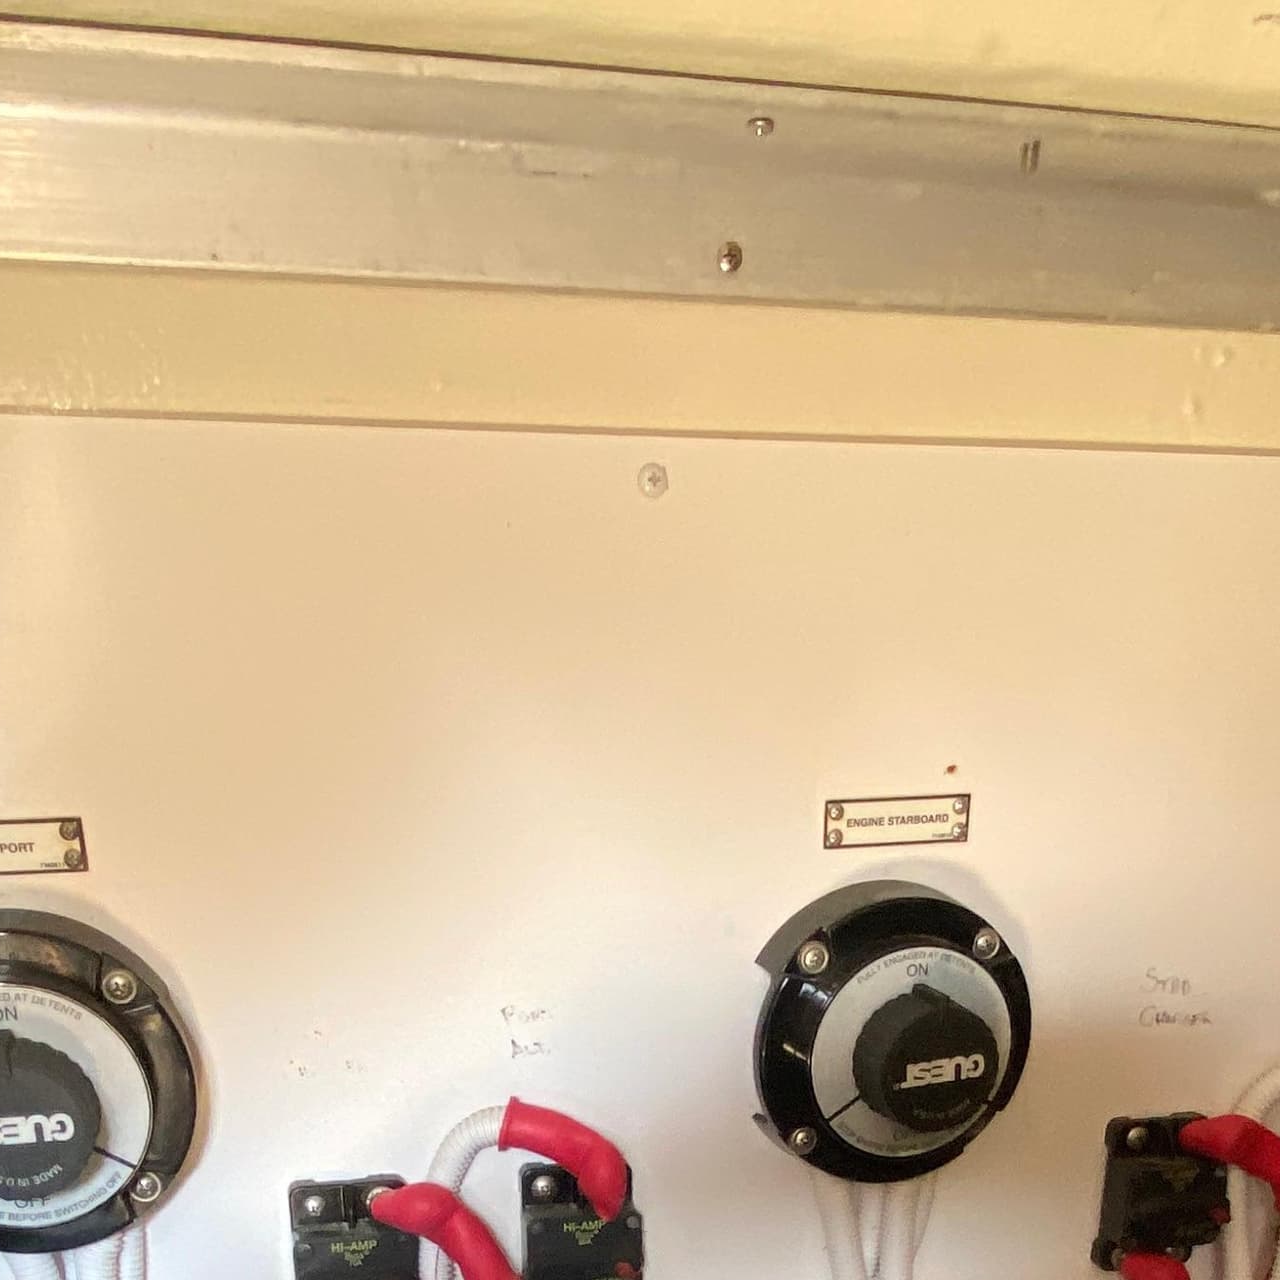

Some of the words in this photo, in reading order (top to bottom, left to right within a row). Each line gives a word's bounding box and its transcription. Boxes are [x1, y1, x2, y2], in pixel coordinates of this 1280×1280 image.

[846, 816, 886, 828] ENGINE
[887, 813, 950, 826] STARBOARD
[0, 842, 36, 854] PORT
[906, 963, 929, 977] ON
[14, 993, 28, 1003] AT
[31, 995, 84, 1022] DETENTS
[900, 1053, 985, 1089] GUEST
[8, 1212, 52, 1221] BEFORE
[54, 1187, 108, 1220] SWITCHING
[331, 1239, 378, 1253] HI-AMP
